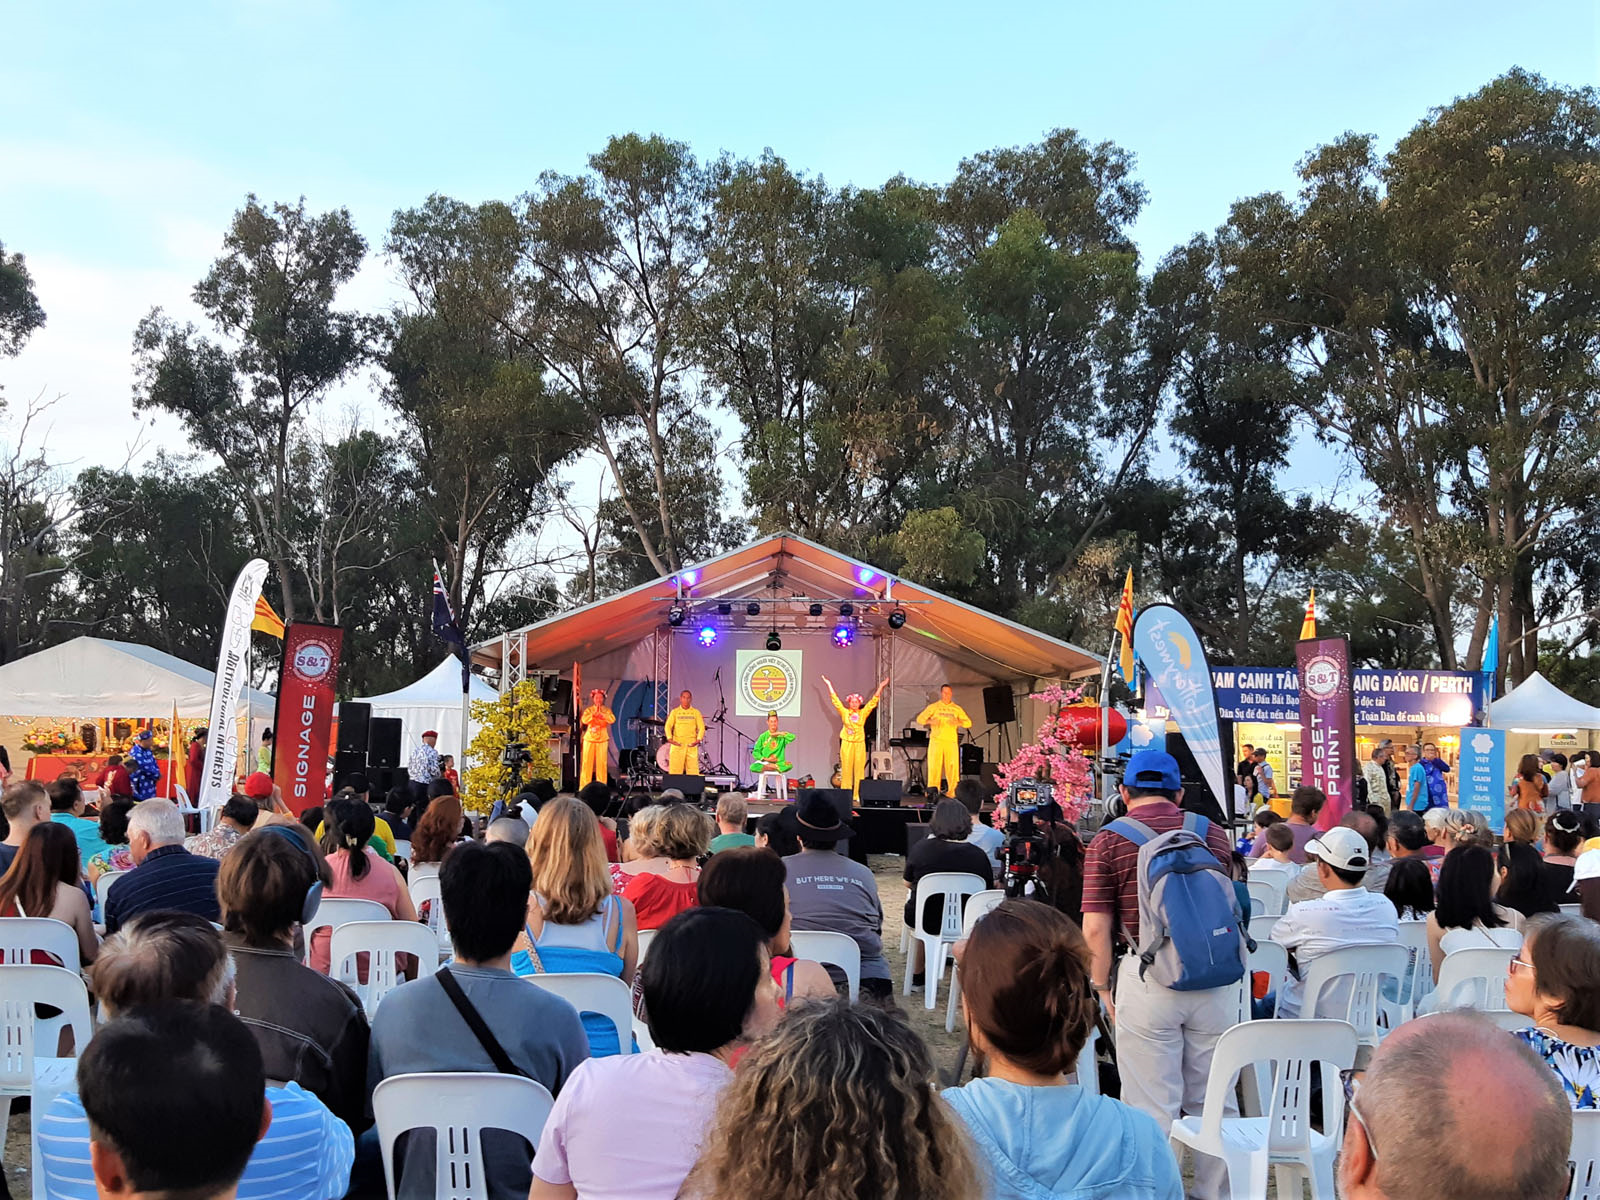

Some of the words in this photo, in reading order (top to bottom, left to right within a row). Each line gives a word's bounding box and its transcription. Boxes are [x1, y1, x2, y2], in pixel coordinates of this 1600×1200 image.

[296, 655, 329, 667] S&T
[1237, 672, 1273, 689] CANH
[1353, 675, 1379, 694] ẠNG
[1430, 676, 1473, 693] PERTH
[1308, 671, 1338, 686] S&T
[1406, 712, 1426, 722] canh
[294, 695, 316, 797] SIGNAGE
[1311, 713, 1325, 791] FFSET
[211, 733, 225, 788] INTERESTS
[1327, 726, 1341, 796] PRINT
[795, 876, 812, 884] BUT
